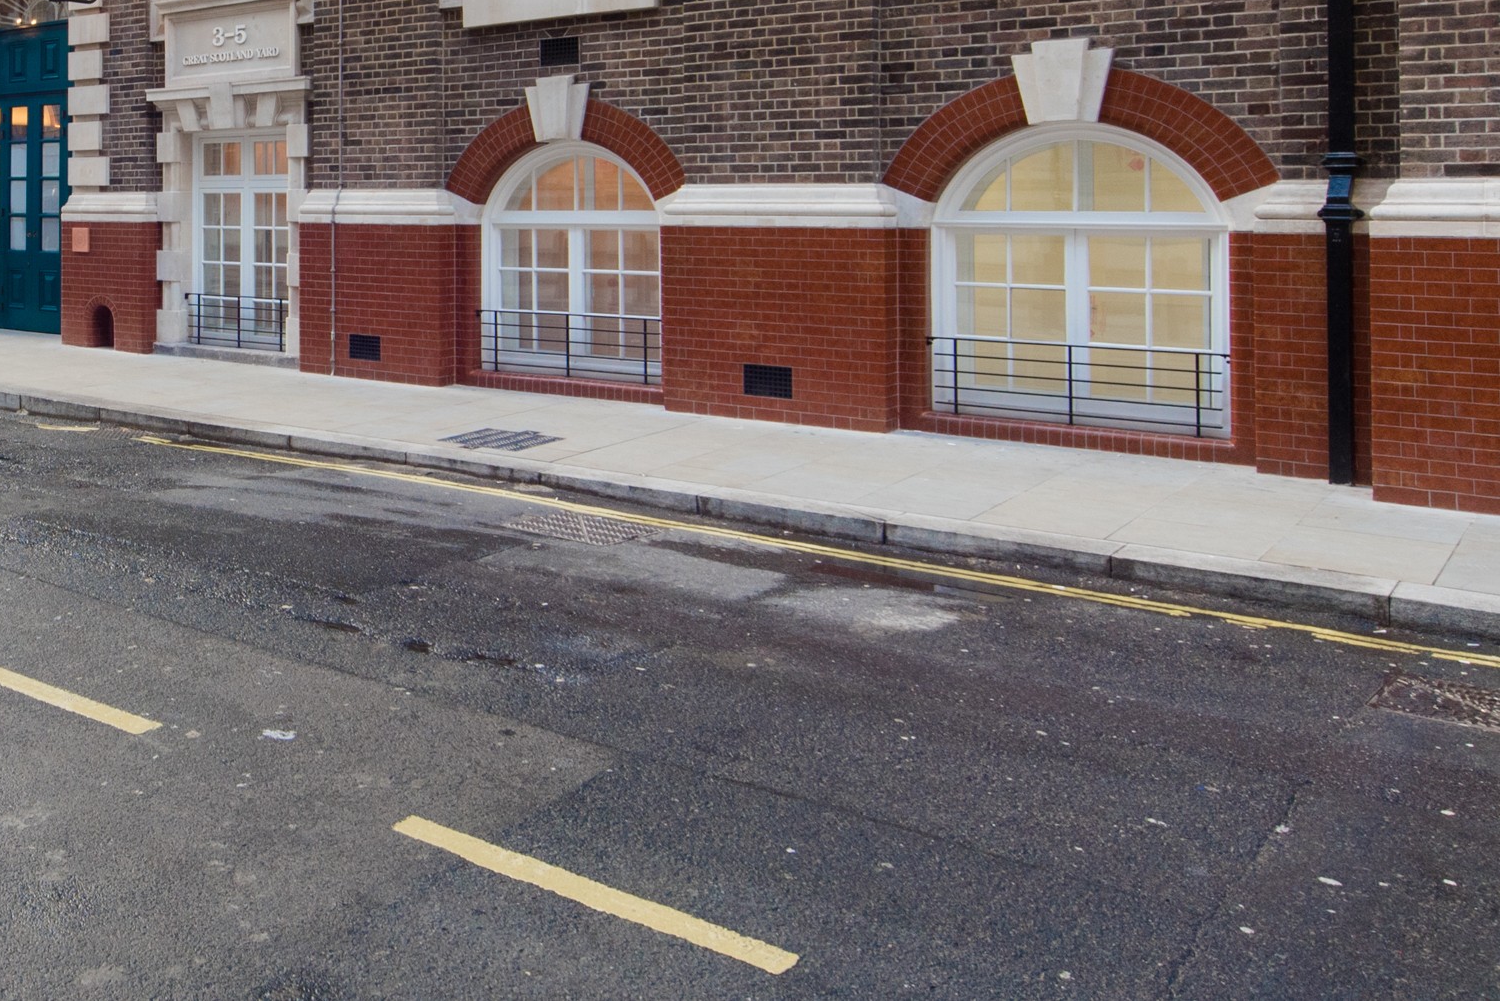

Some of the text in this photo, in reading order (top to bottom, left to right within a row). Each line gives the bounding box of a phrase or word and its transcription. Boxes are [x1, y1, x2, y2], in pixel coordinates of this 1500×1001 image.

[212, 24, 248, 47] 3-5
[182, 47, 280, 66] GREAT SCOTLAND YARD
